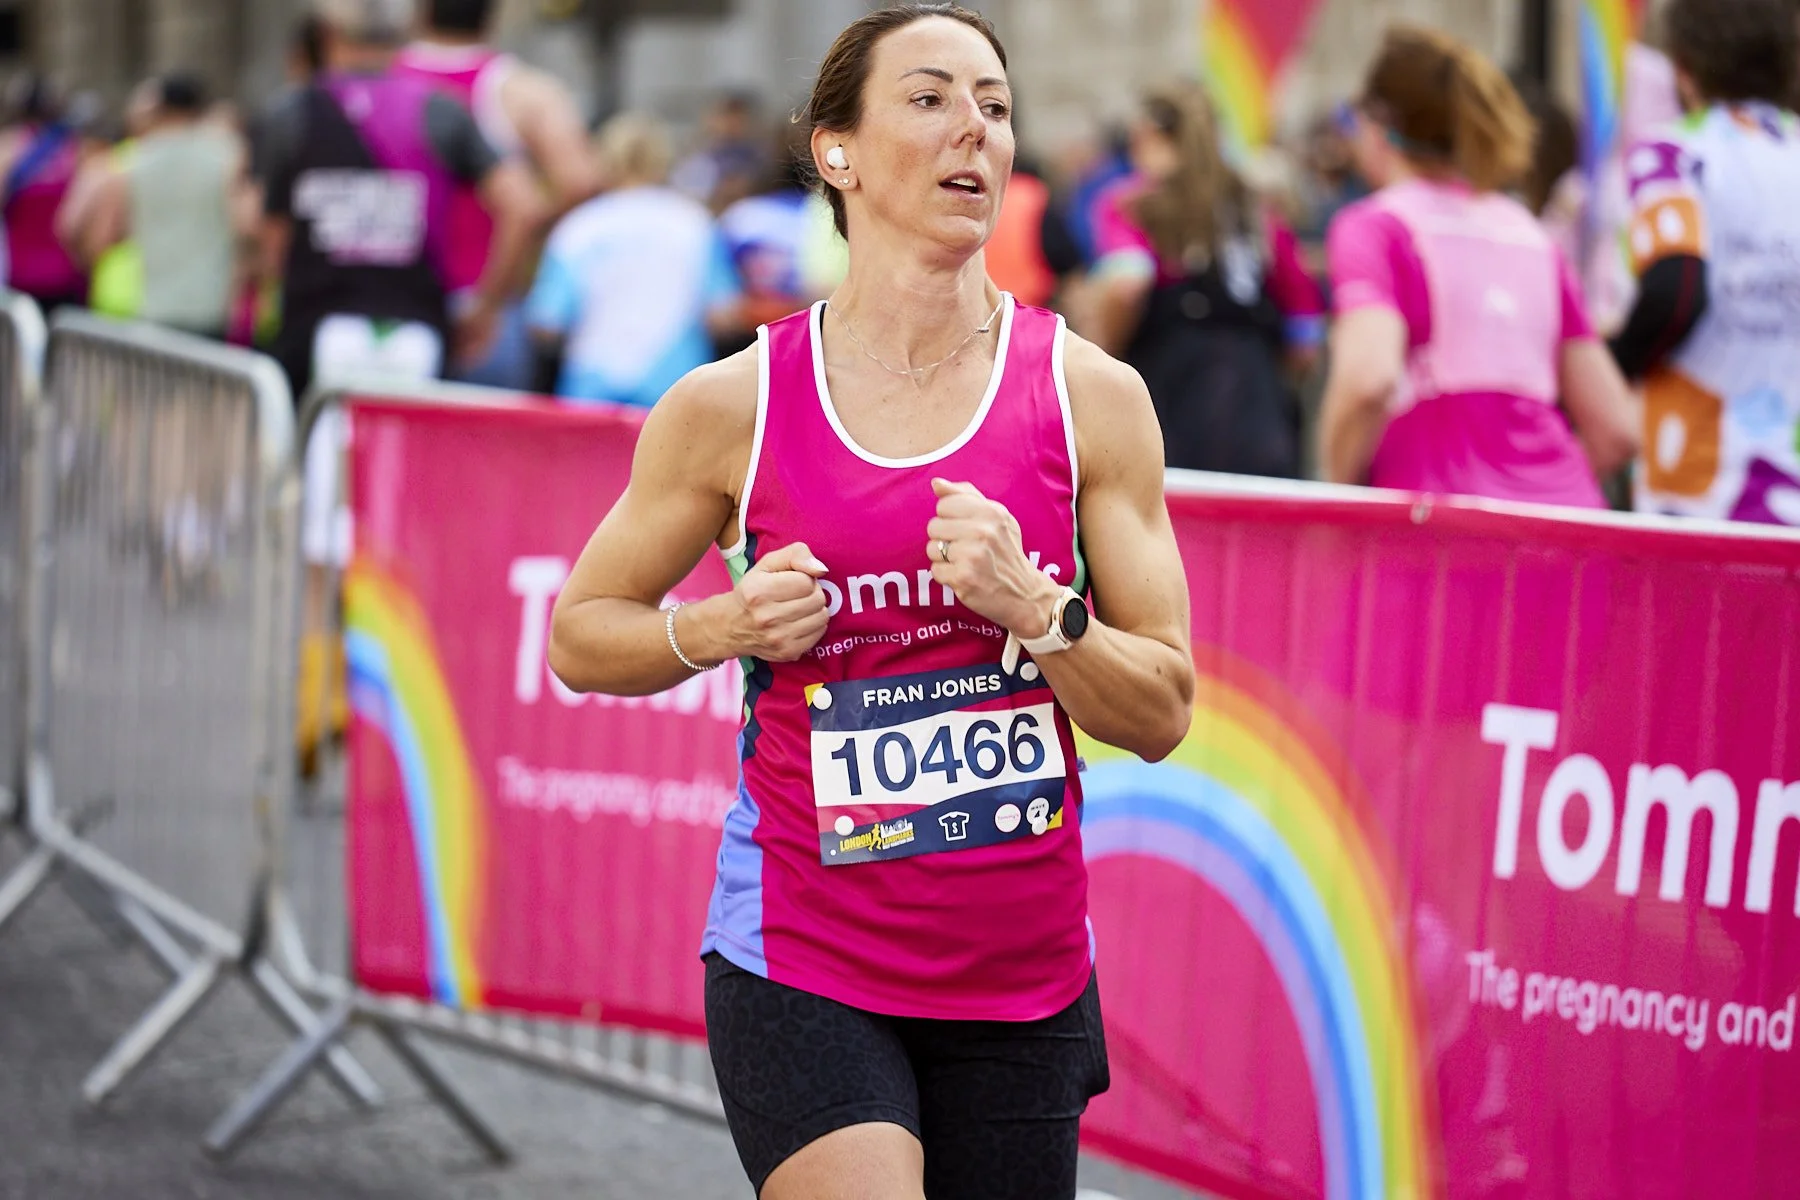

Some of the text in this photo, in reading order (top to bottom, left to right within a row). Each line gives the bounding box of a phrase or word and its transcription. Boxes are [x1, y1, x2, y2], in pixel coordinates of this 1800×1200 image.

[816, 631, 911, 659] pregnancy
[916, 619, 951, 640] and
[957, 620, 1003, 638] baby
[862, 674, 1002, 708] FRAN JONES
[831, 712, 1046, 797] 10466
[839, 832, 873, 853] LONDON
[951, 821, 959, 834] S
[1466, 949, 1797, 1053] The pregnancy and
